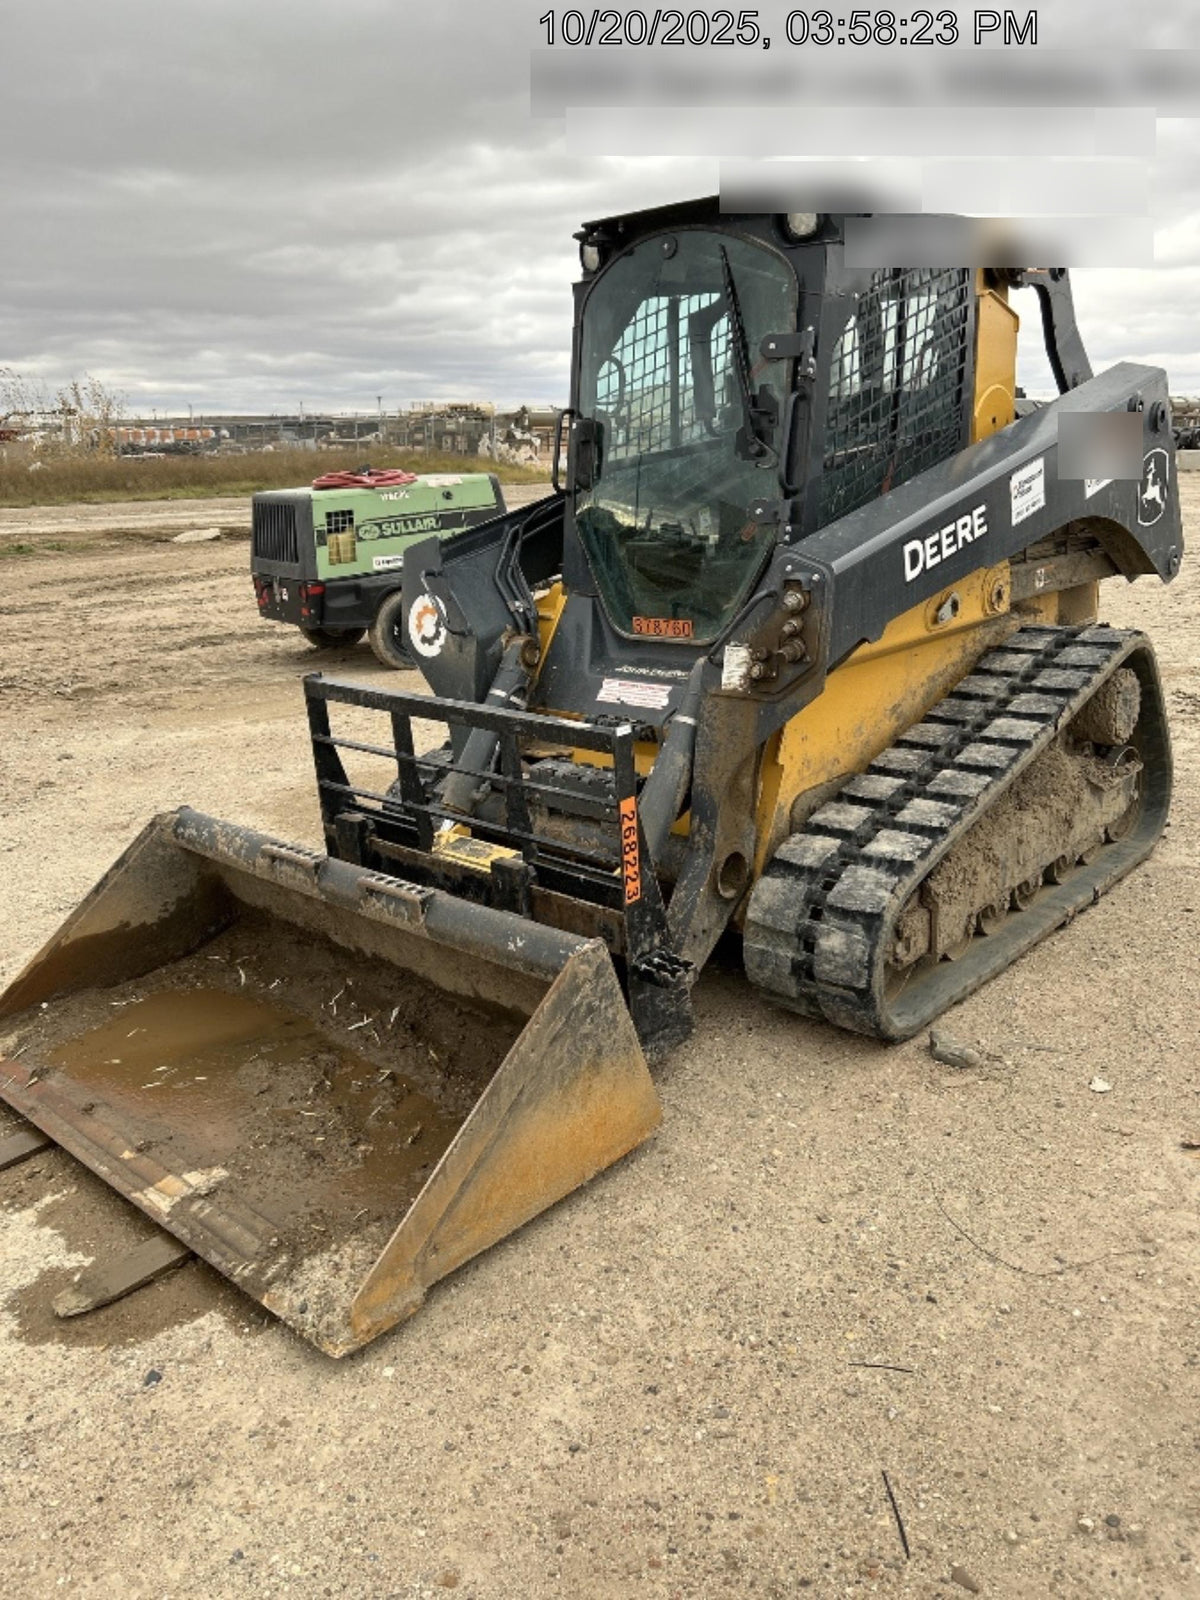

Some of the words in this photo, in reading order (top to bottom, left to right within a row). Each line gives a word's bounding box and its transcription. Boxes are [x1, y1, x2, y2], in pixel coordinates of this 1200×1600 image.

[382, 517, 437, 535] SULLAIR
[902, 504, 988, 582] DEERE
[621, 810, 639, 900] 268223
